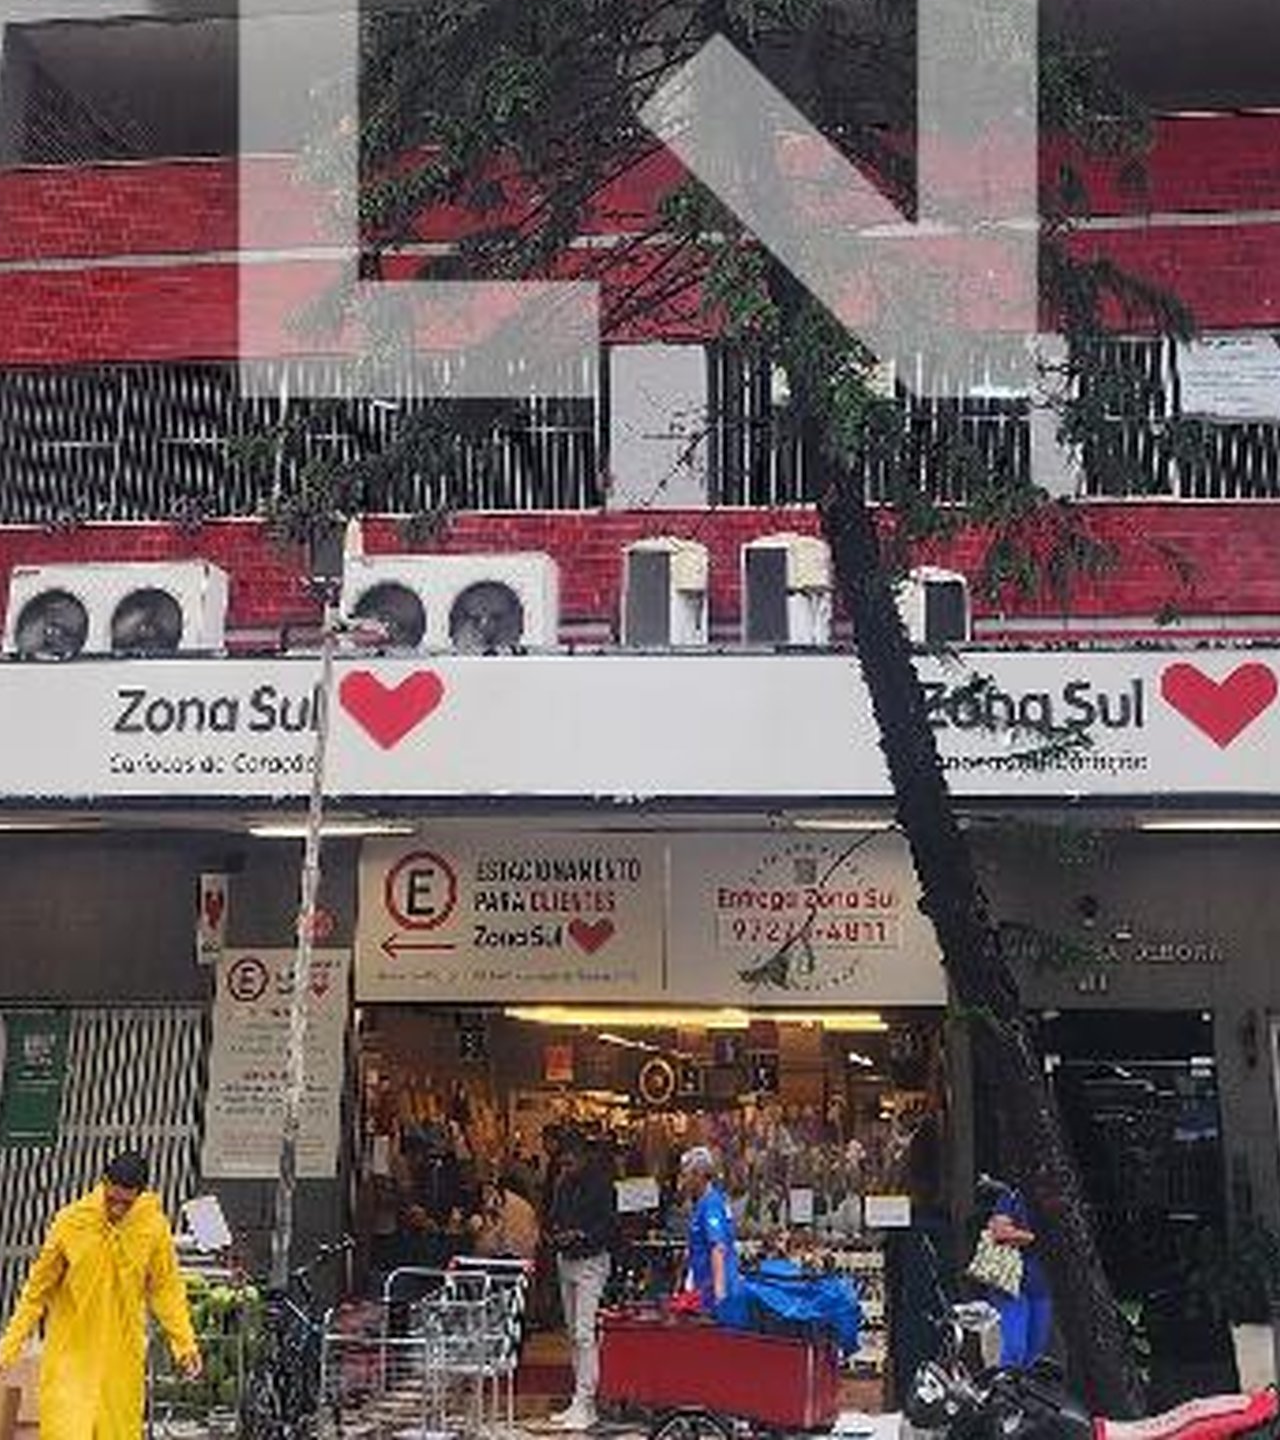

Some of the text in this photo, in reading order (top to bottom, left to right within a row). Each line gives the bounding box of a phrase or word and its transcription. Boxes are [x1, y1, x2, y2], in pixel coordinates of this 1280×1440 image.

[113, 680, 324, 734] Zona Sul
[919, 677, 1144, 730] Zona Sul
[476, 859, 642, 883] ESTACIONAMENTO
[406, 868, 435, 916] E
[474, 891, 617, 912] PARA CLIENTES
[717, 888, 798, 911] Entrega
[803, 888, 859, 910] Zona
[473, 925, 528, 949] Zona
